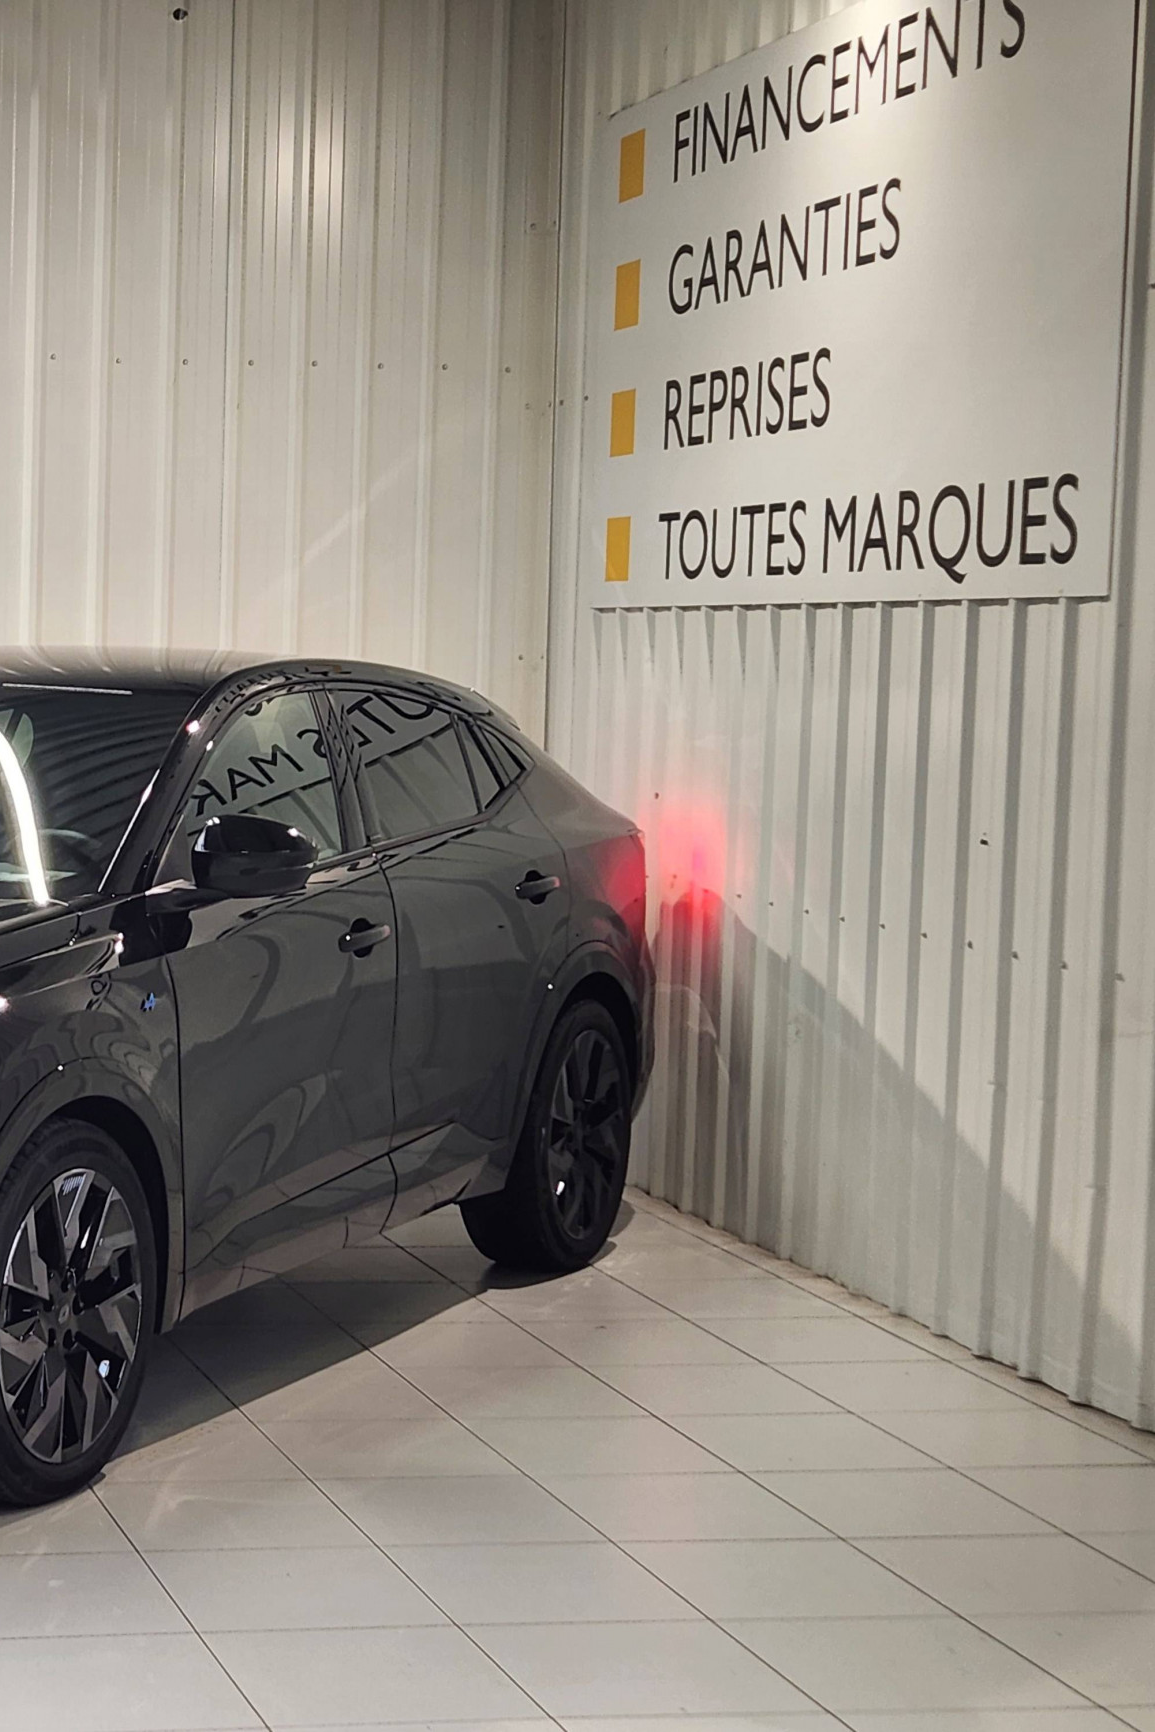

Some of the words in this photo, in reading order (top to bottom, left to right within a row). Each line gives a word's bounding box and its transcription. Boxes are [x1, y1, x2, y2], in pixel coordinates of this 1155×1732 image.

[672, 0, 1026, 184] FINANCEMENTS
[667, 177, 902, 315] GARANTIES
[662, 347, 832, 450] REPRISES
[658, 500, 808, 581] TOUTES
[822, 473, 1080, 585] MARQUES
